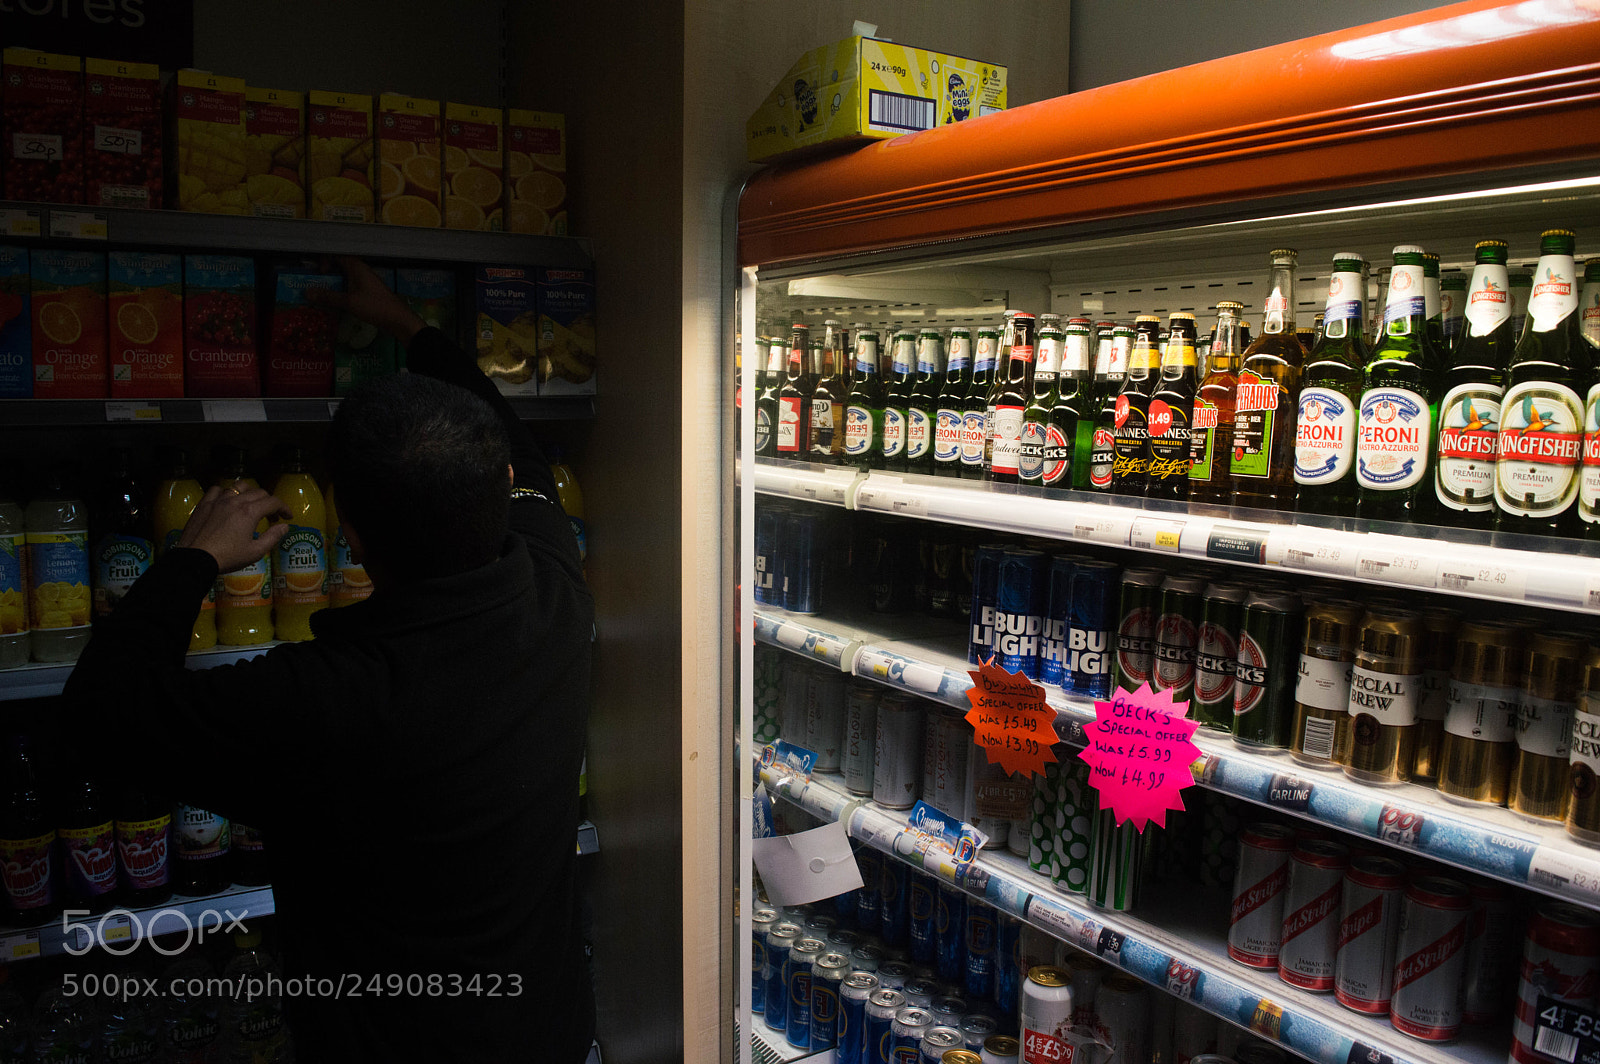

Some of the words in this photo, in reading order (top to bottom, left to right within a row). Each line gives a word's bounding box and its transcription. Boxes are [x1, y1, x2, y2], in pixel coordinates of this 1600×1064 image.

[118, 66, 127, 74] £1
[108, 83, 147, 93] Cranberry
[952, 89, 968, 99] Mini
[200, 95, 224, 103] Mango
[799, 90, 813, 104] Mini
[800, 96, 817, 112] eggs
[952, 97, 970, 110] eggs
[407, 101, 414, 109] £1
[23, 142, 56, 161] 50p
[102, 136, 136, 153] 50p
[485, 288, 506, 298] 100%
[508, 290, 526, 298] Pure
[546, 291, 566, 300] 100%
[567, 291, 585, 299] Pure
[1472, 291, 1507, 303] KINGFISHER
[1534, 284, 1571, 296] KINGFISHER
[45, 349, 98, 369] Orange
[123, 349, 174, 369] Orange
[189, 348, 254, 367] Cranberry
[271, 358, 332, 375] Cranberry
[1360, 426, 1419, 443] PERONI
[1309, 441, 1343, 449] AZZURRO
[1381, 443, 1419, 452] AZZURRO
[1498, 432, 1581, 460] KINGFISHER
[1452, 470, 1491, 480] PREMIUM
[1512, 472, 1553, 483] PREMIUM
[283, 533, 322, 552] ROBINSONS
[1219, 538, 1248, 546] IMPOSSIBLY
[101, 542, 147, 561] ROBINSONS
[1316, 547, 1341, 560] £3.49
[114, 558, 135, 566] Real
[289, 555, 317, 565] Fruit
[1393, 557, 1418, 569] £3.19
[47, 568, 77, 576] Squash
[109, 566, 140, 578] Fruit
[1478, 570, 1506, 583] £2.49
[977, 696, 1014, 709] SPECIAL
[1017, 702, 1047, 714] OFFER
[1351, 688, 1393, 711] BREW
[1112, 697, 1174, 726] BECK'S
[1003, 717, 1037, 732] £5.49
[1097, 720, 1151, 738] SPECIAL
[1155, 731, 1190, 745] OFFER
[1005, 737, 1039, 755] £3.99
[1128, 746, 1171, 762] £5.99
[1094, 761, 1115, 778] NOW
[1121, 768, 1165, 790] £4.99
[1270, 788, 1308, 802] CARLING
[184, 811, 214, 821] Fruit
[1490, 834, 1522, 852] ENJOY
[125, 839, 166, 870] Vimto
[0, 858, 47, 889] Vimto
[132, 863, 161, 876] squash
[13, 881, 43, 895] squash
[1246, 936, 1278, 947] JAMAICAN
[1298, 957, 1332, 968] JAMAICAN
[1414, 1005, 1451, 1017] JAMAICAN
[1540, 1005, 1558, 1025] 4
[239, 1014, 283, 1034] Volvic
[1254, 1007, 1281, 1032] COBRA
[172, 1022, 218, 1043] Volvic
[108, 1040, 155, 1058] Volvic
[1026, 1033, 1036, 1053] 4
[1042, 1038, 1072, 1060] £5.79
